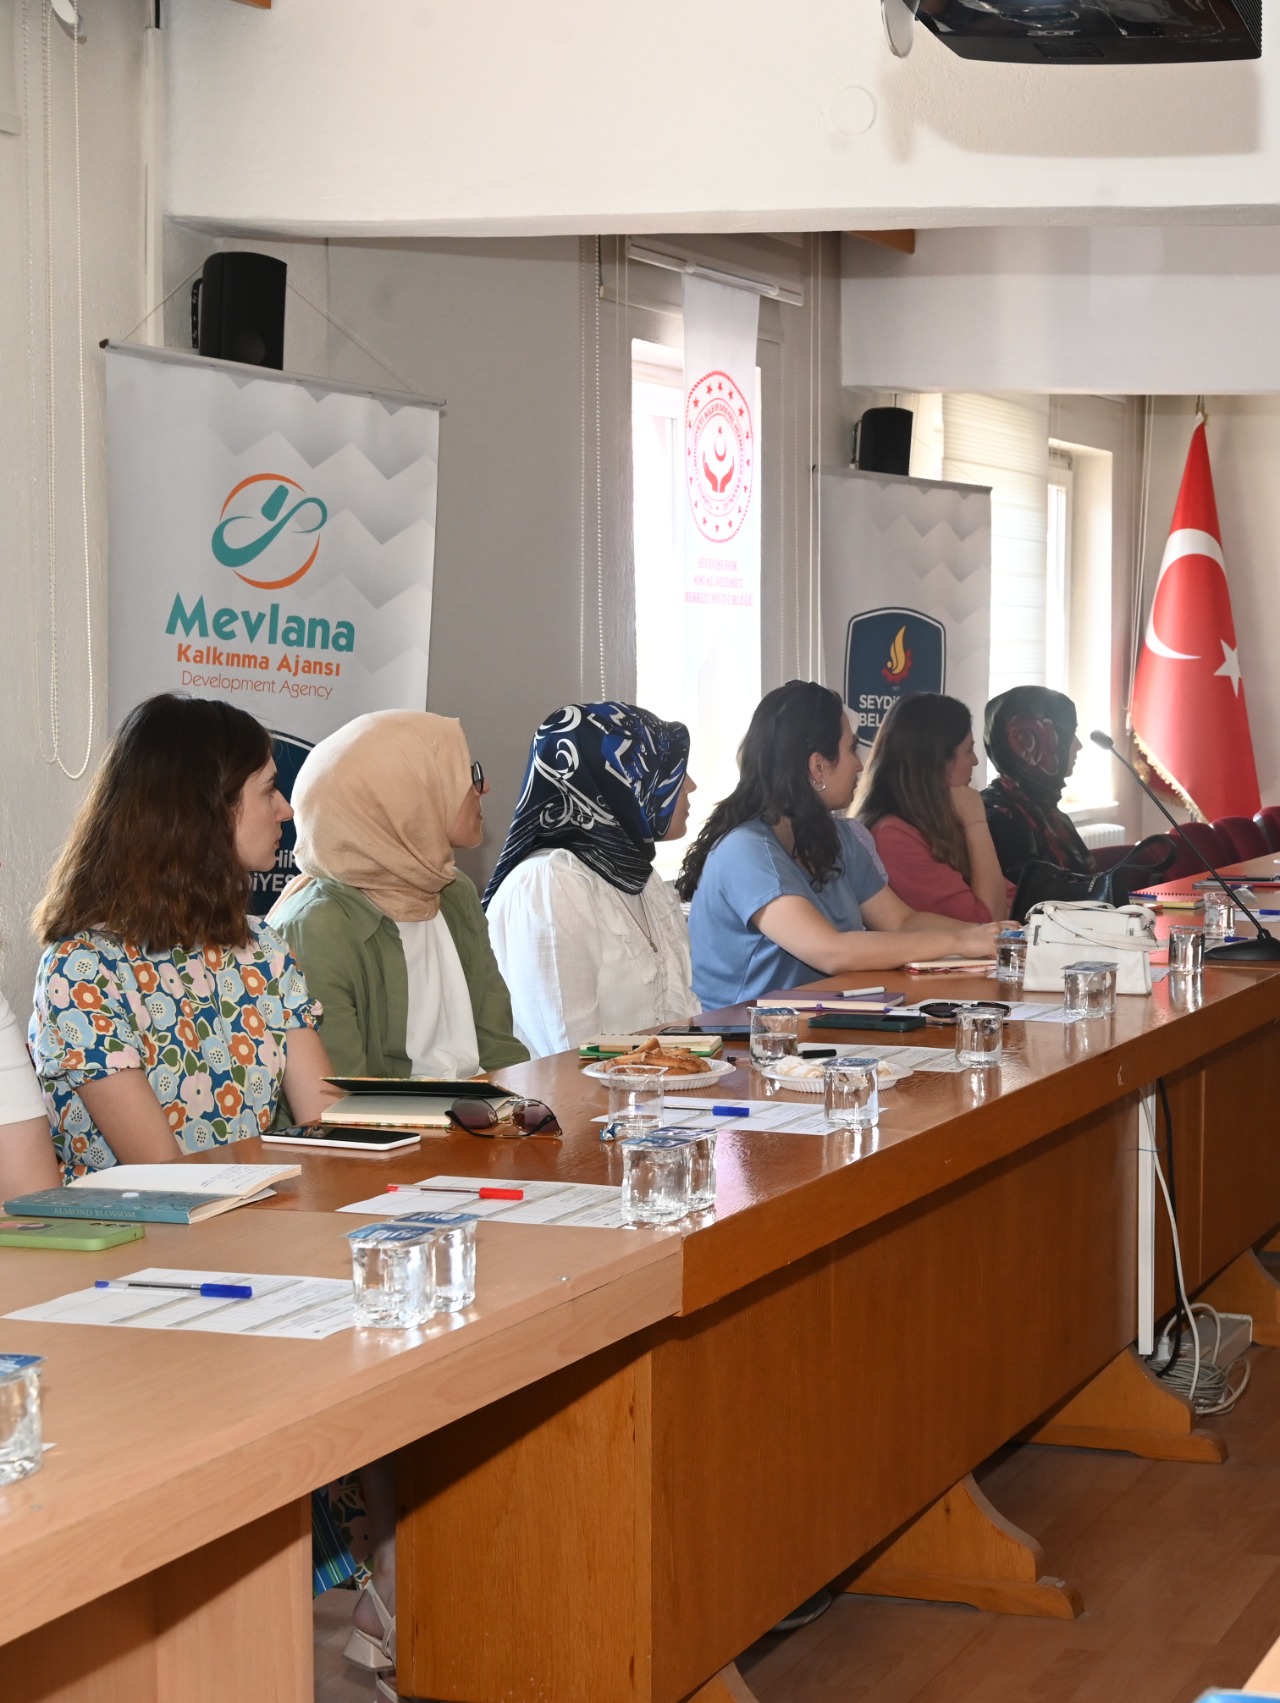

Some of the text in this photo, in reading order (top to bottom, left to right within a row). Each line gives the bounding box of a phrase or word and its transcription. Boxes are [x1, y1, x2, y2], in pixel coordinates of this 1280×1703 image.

[165, 592, 356, 652] Mevlana
[177, 643, 341, 677] Kalkınma Ajansı
[182, 670, 333, 701] Development Agency
[54, 1207, 136, 1219] ALMOND BLOSSOM
